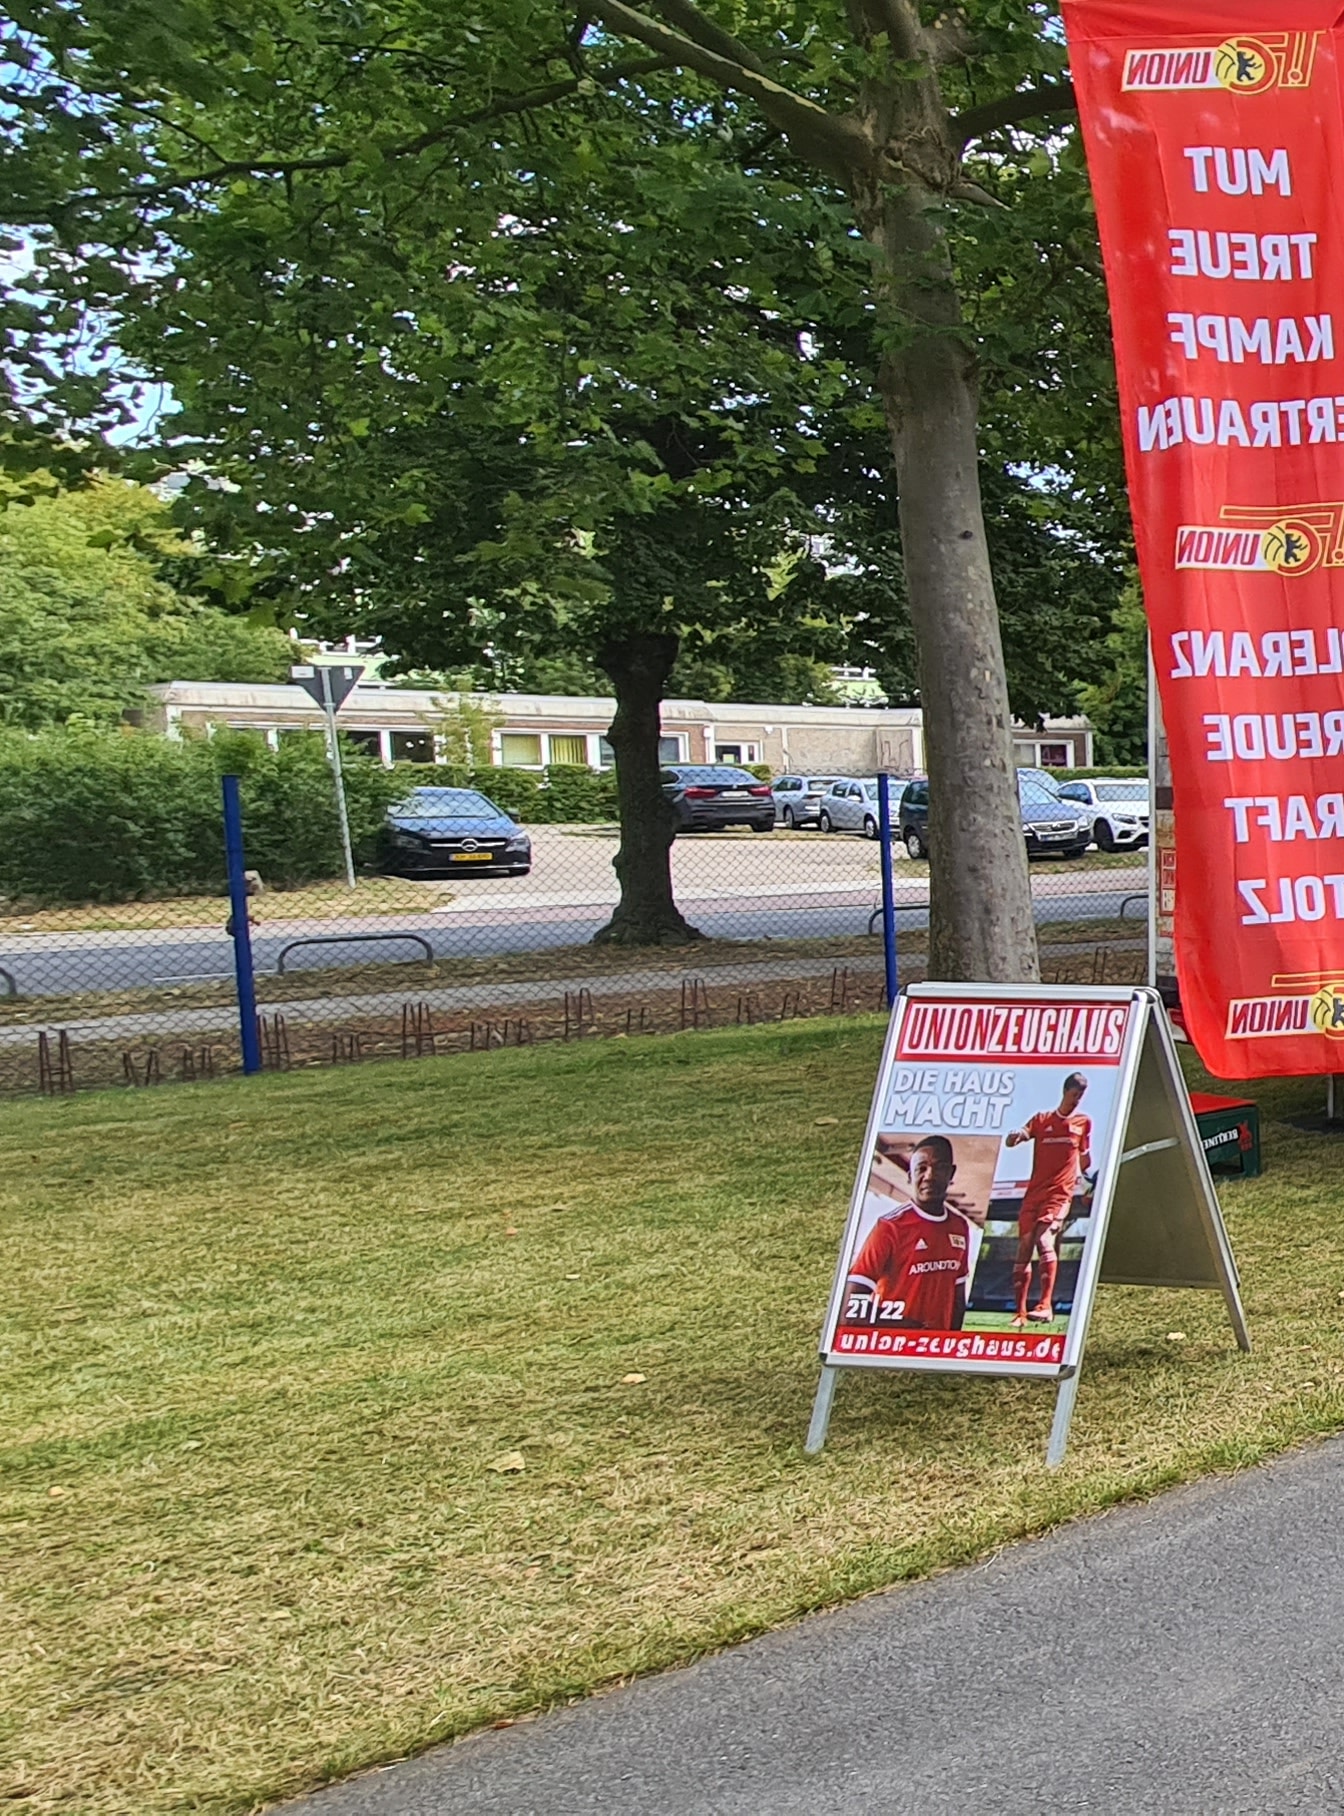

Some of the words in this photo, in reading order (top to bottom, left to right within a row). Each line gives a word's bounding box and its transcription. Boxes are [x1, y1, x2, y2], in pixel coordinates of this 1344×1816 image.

[894, 1068, 938, 1093] DIE
[943, 1069, 1015, 1095] HAUS
[883, 1093, 1013, 1129] MACHT
[840, 1331, 1061, 1358] union-zeughaus.de
